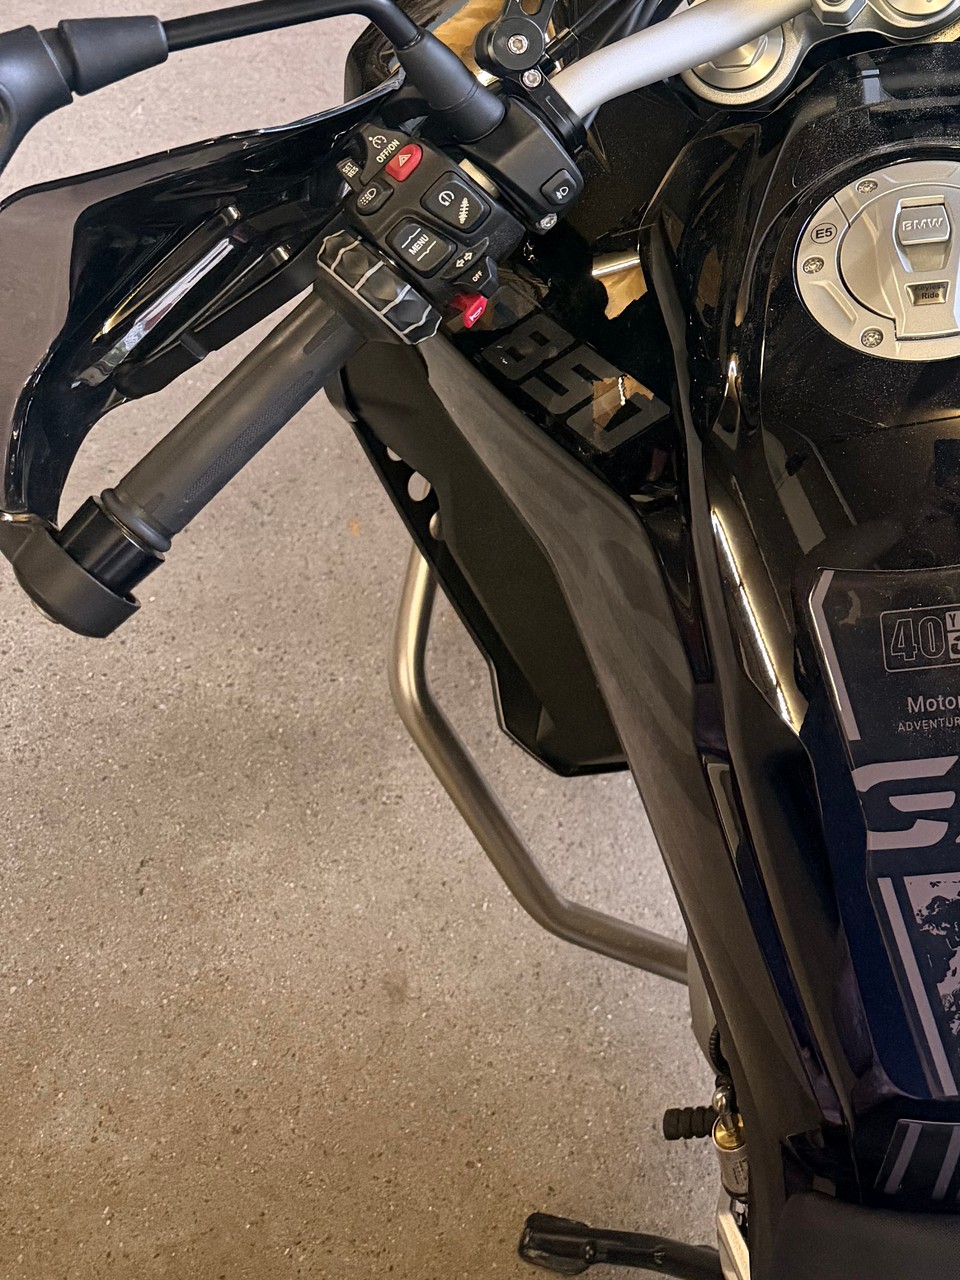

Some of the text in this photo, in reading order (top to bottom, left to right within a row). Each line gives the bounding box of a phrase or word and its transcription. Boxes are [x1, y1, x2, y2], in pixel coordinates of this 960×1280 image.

[375, 138, 400, 163] OFF/ON
[342, 161, 354, 174] SET
[347, 165, 360, 179] RES
[902, 217, 944, 231] BMW
[814, 227, 833, 239] E5
[407, 233, 430, 257] MENU
[471, 270, 483, 282] OFF
[921, 291, 940, 300] Ride
[890, 615, 946, 662] 40
